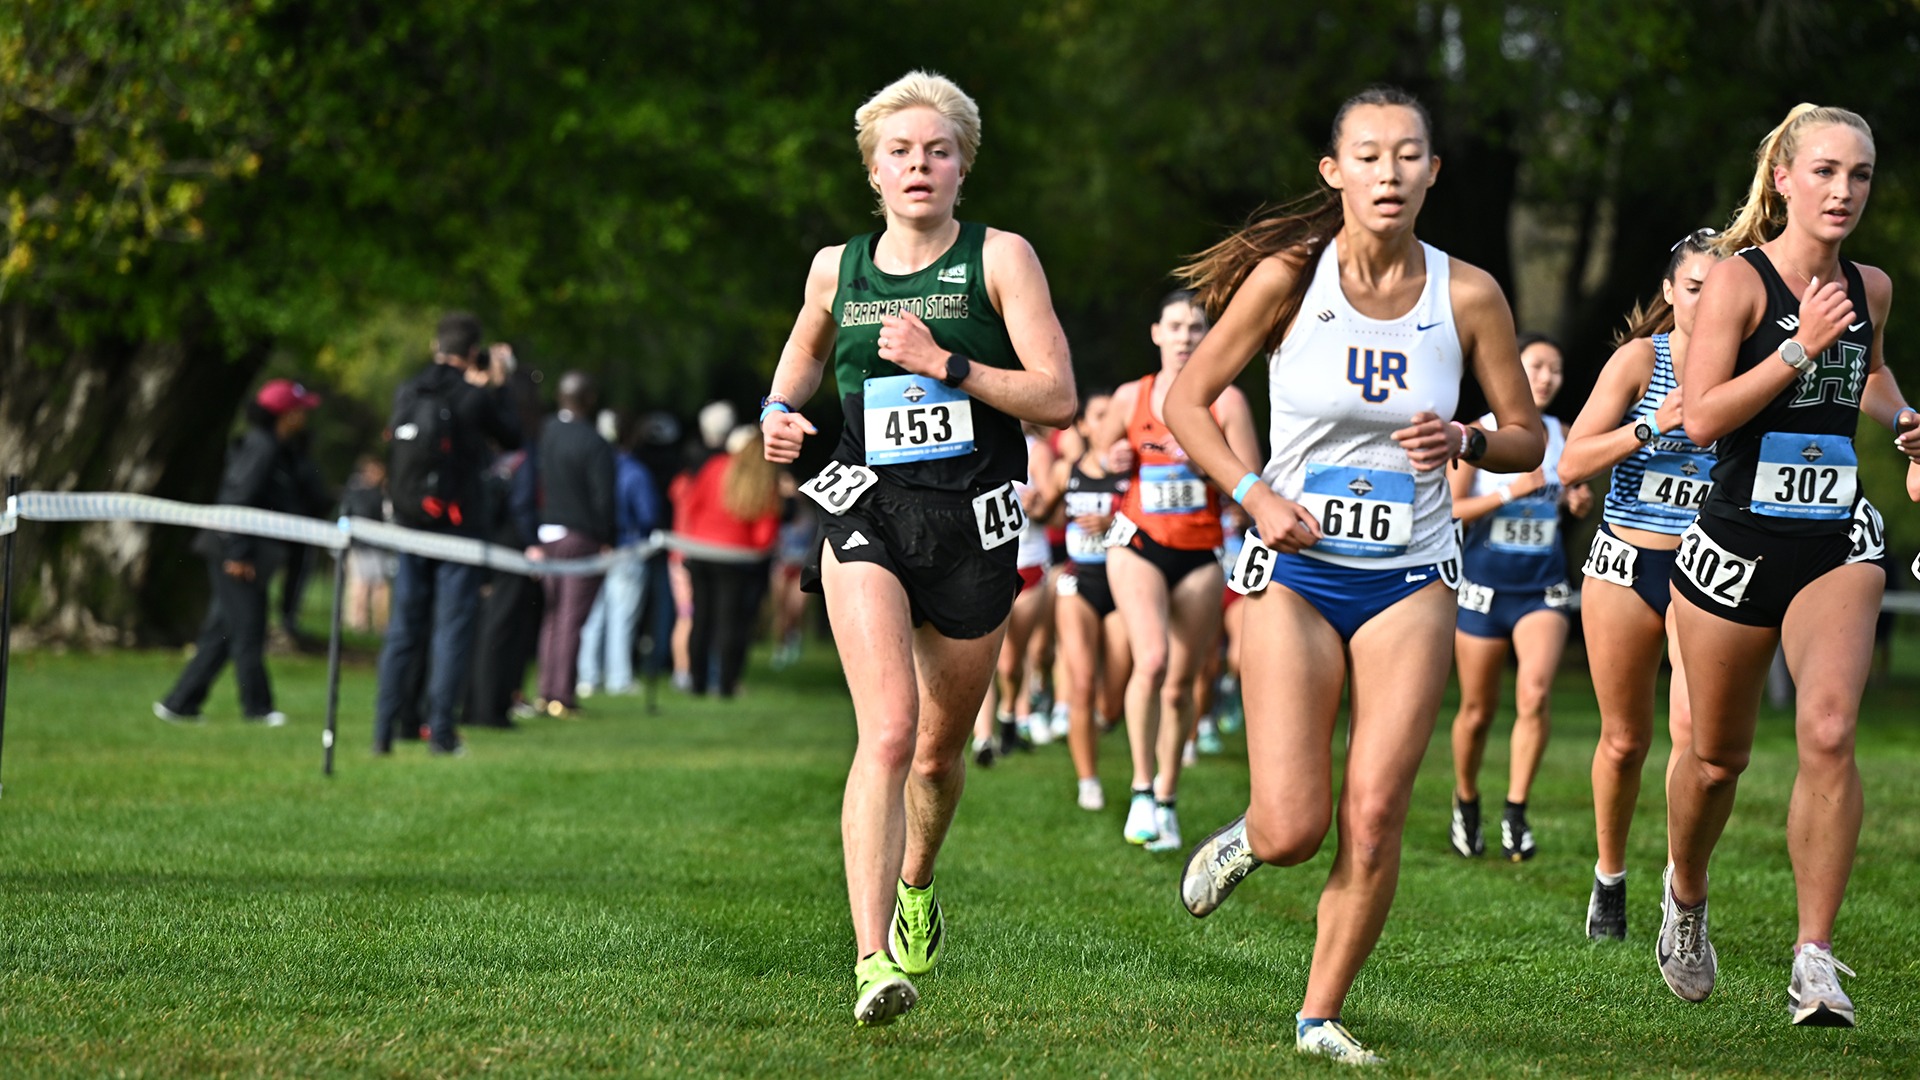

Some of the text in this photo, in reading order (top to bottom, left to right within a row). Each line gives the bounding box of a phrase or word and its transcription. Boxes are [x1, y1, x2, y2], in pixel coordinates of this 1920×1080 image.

[925, 294, 969, 319] STATE
[1345, 346, 1409, 403] UCR
[885, 406, 952, 446] 453
[807, 463, 867, 507] 53
[1655, 477, 1710, 509] 464
[1775, 466, 1838, 504] 302
[1322, 498, 1391, 541] 616
[1504, 521, 1543, 544] 585
[1681, 532, 1746, 603] 302
